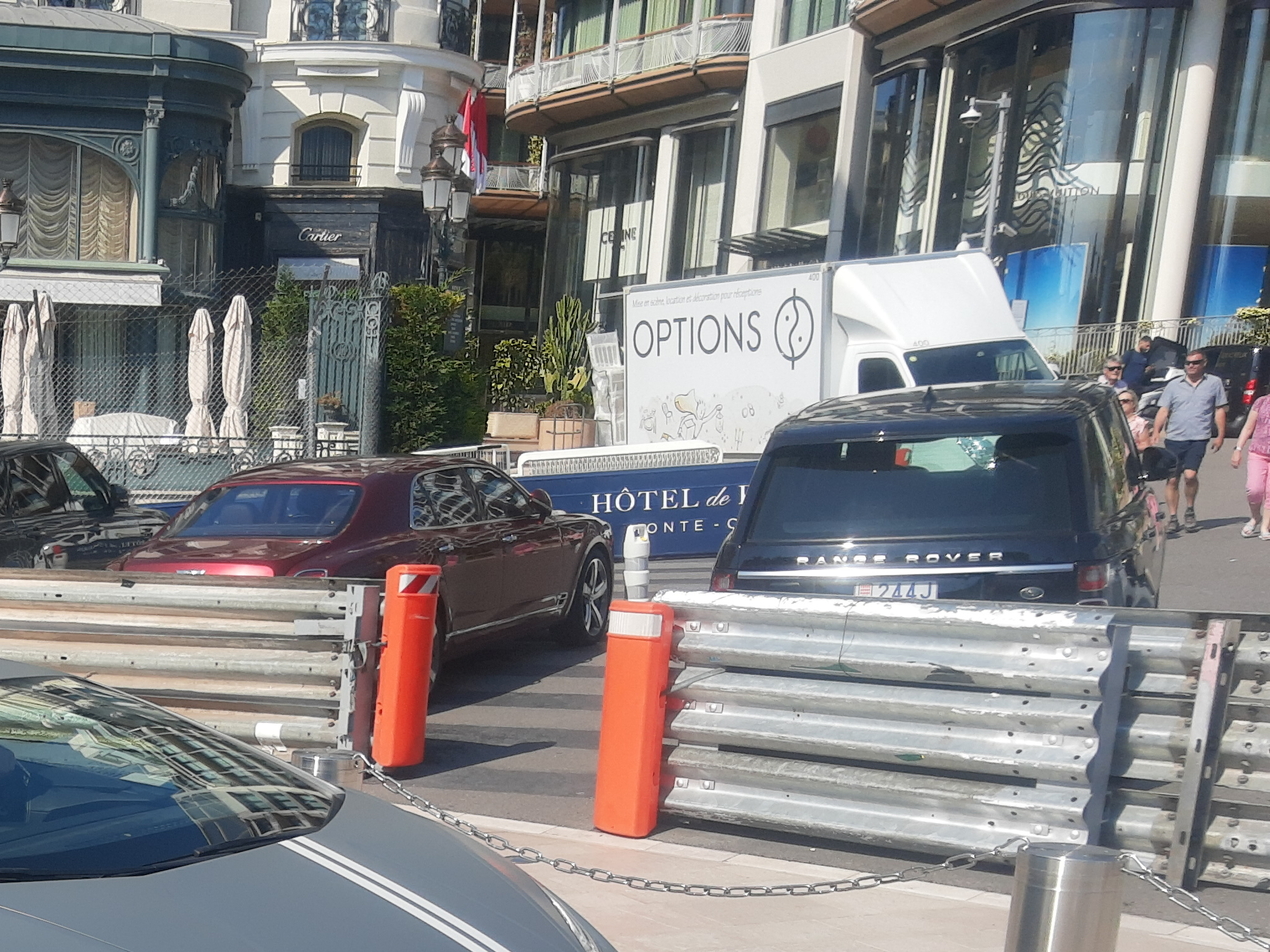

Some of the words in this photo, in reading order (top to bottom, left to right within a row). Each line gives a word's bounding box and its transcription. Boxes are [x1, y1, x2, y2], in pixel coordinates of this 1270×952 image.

[298, 227, 342, 242] Cartier
[633, 310, 762, 358] OPTIONS
[592, 487, 700, 513] HÔTEL
[706, 486, 731, 507] de
[796, 553, 888, 566] RANGE
[905, 551, 1004, 564] ROVER
[878, 582, 933, 599] 244J
